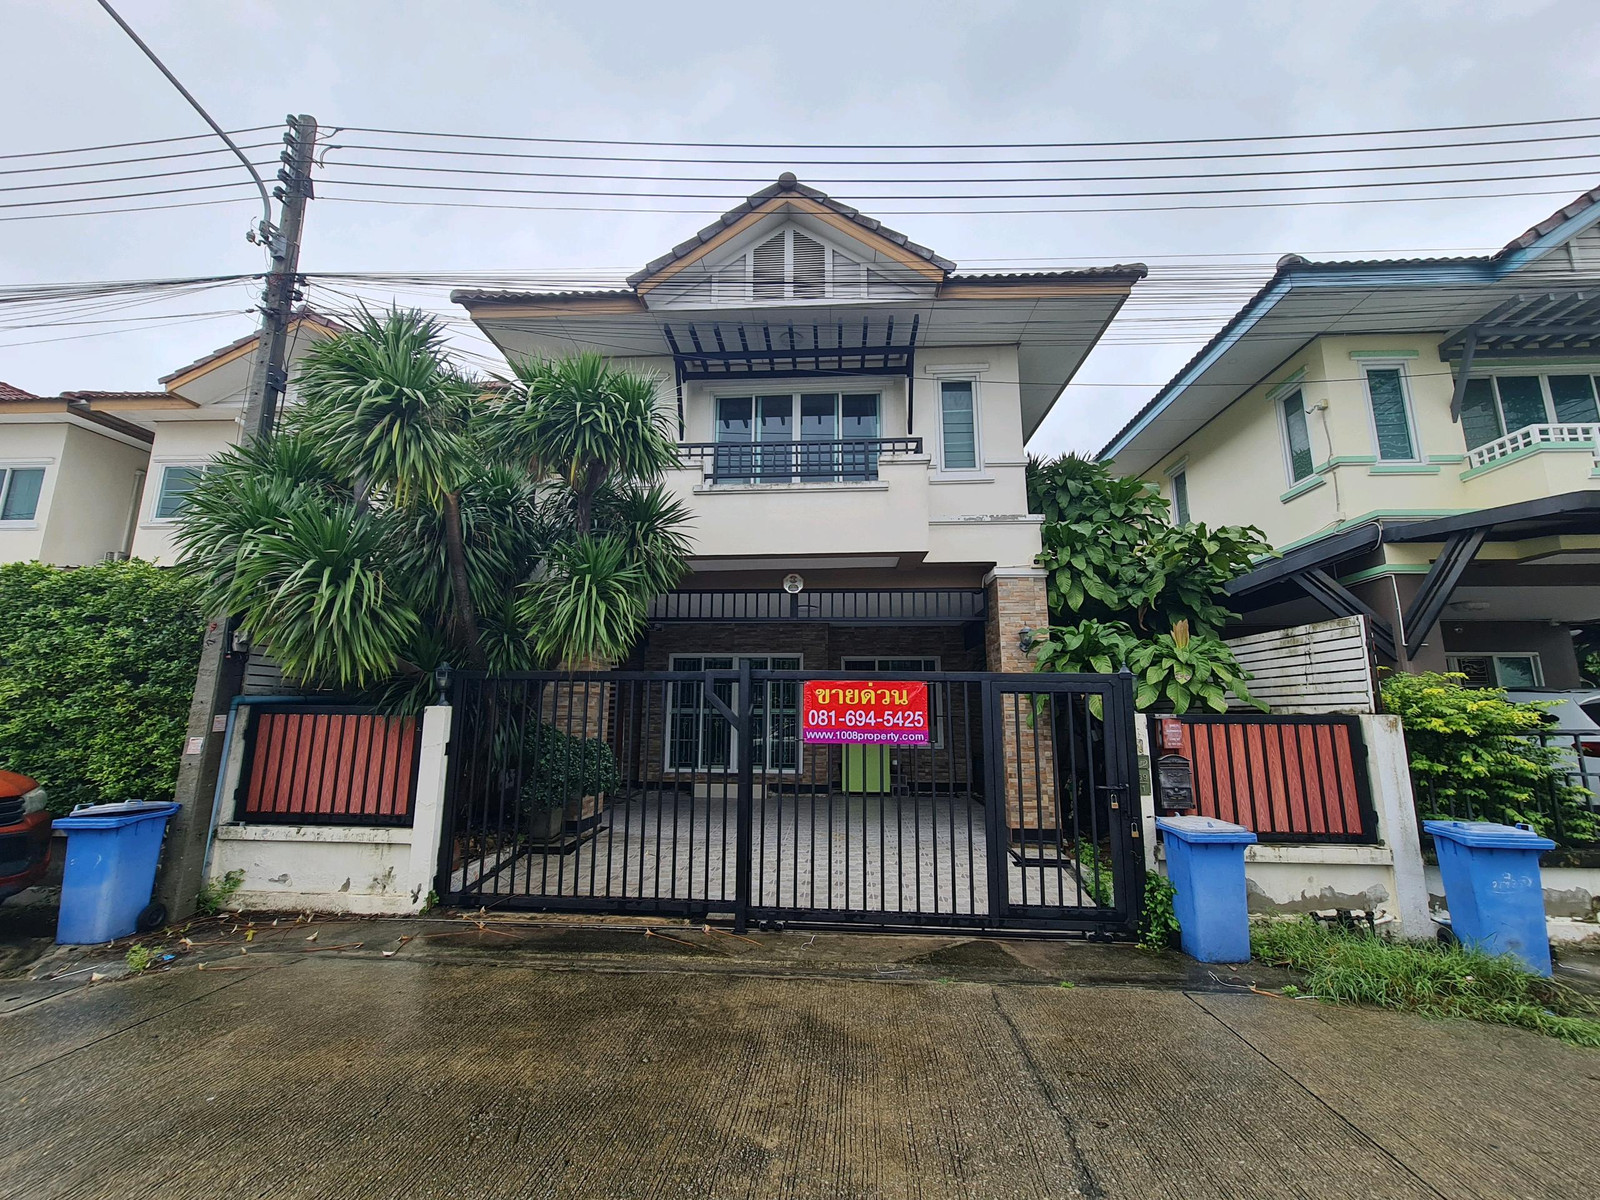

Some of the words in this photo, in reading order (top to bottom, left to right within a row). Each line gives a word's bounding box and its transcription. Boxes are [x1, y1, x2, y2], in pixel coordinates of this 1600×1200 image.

[815, 682, 909, 705] ขายด่วน
[808, 709, 924, 727] 081-694-5425
[806, 731, 924, 742] www.1008property.com
